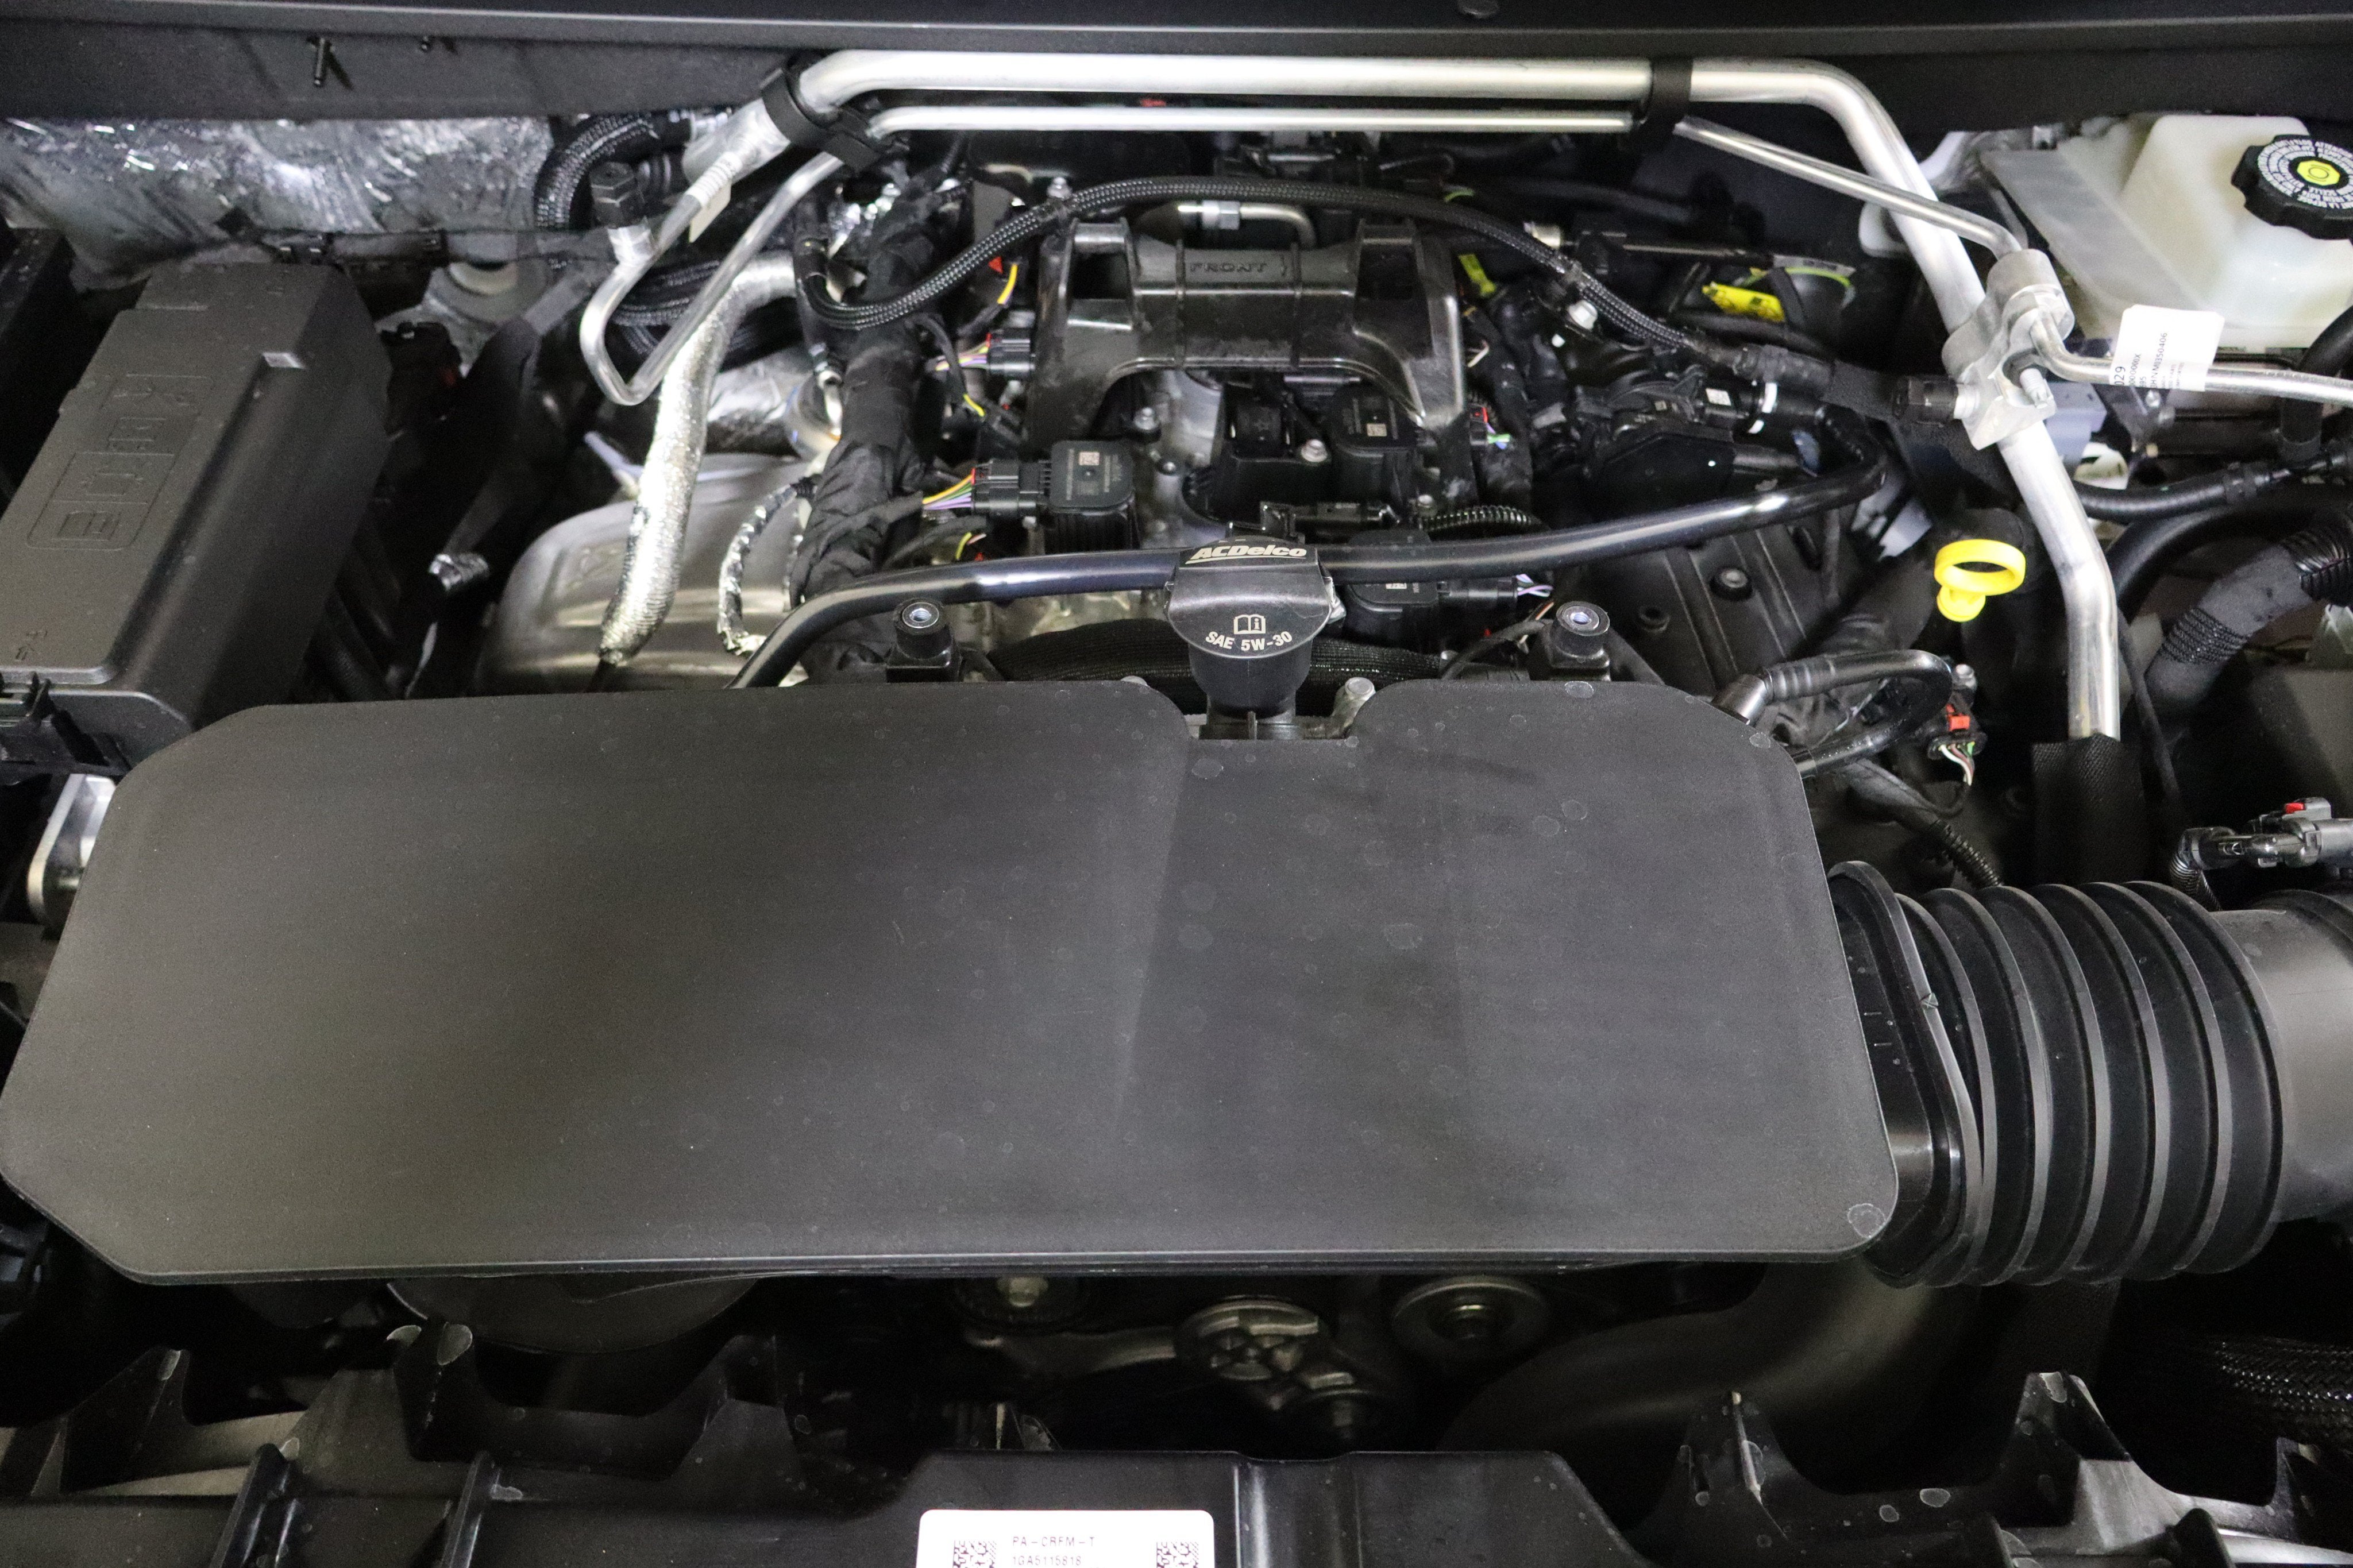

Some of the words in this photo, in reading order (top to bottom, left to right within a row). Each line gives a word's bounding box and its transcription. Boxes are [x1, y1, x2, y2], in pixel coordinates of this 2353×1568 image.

[1190, 262, 1268, 273] FRONT
[1189, 544, 1307, 561] ACDelco
[1205, 631, 1235, 650] SAE
[1241, 631, 1293, 651] 5W-30
[1013, 1555, 1082, 1566] 1GA5115818
